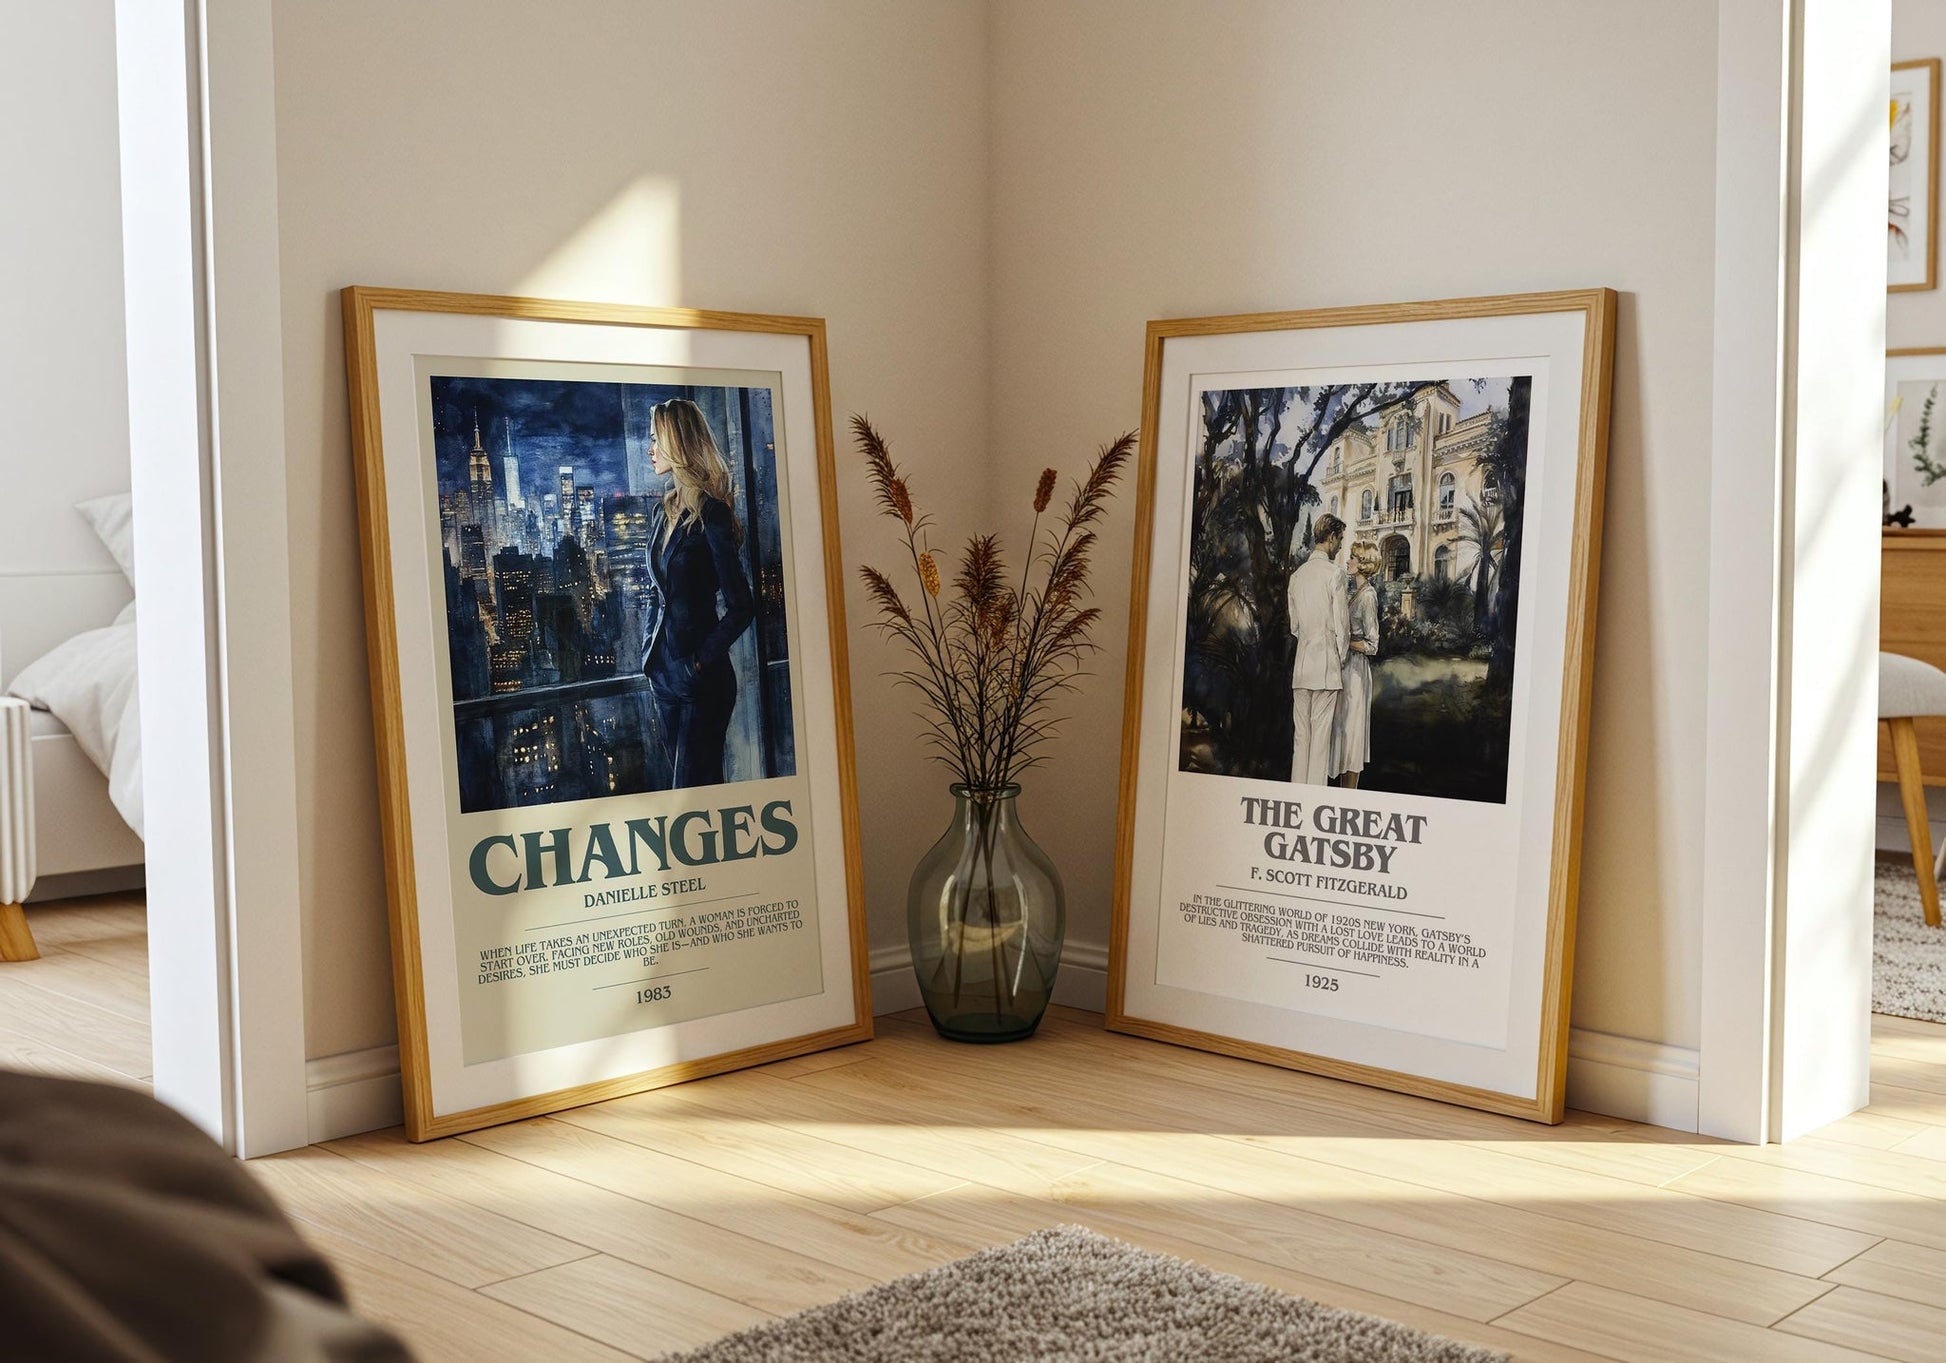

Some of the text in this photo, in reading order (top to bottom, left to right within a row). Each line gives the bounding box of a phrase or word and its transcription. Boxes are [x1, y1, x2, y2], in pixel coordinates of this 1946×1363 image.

[1241, 797, 1427, 844] THE GREAT
[469, 800, 798, 896] CHANGES
[1264, 832, 1398, 874] GATSBY
[584, 878, 706, 908] DANIELLE STEEL
[1251, 867, 1408, 900] F. SCOTT FITZGERALD
[480, 947, 512, 960] WHEN
[515, 943, 537, 954] LIFE
[540, 937, 573, 949] TAKES
[576, 934, 590, 944] AN
[592, 922, 656, 942] UNEXPECTED
[690, 917, 696, 925] A
[698, 911, 734, 924] WOMAN
[737, 909, 746, 918] IS
[748, 902, 783, 916] FORCED
[786, 900, 798, 909] TO
[1179, 903, 1486, 958] DESTRUCTIVE OBSESSION WITH A LOST LOVE LEADS TO A WORLD
[1193, 894, 1202, 903] IN
[1204, 895, 1221, 906] THE
[1224, 899, 1275, 915] GLITTERING
[1278, 907, 1311, 920] WORLD
[1315, 912, 1327, 922] OF
[1331, 915, 1361, 928] 1920S
[1364, 920, 1385, 931] NEW
[480, 958, 513, 972] START
[552, 947, 589, 960] FACING
[593, 941, 614, 952] NEW
[656, 931, 675, 942] OLD
[725, 920, 744, 931] AND
[747, 910, 799, 927] UNCHARTED
[529, 963, 550, 975] SHE
[553, 959, 580, 971] MUST
[584, 951, 621, 966] DECIDE
[624, 947, 647, 958] WHO
[650, 942, 669, 954] SHE
[713, 931, 734, 943] WHO
[738, 927, 755, 939] SHE
[758, 922, 788, 935] WANTS
[791, 920, 802, 929] TO
[643, 956, 659, 967] BE.
[1184, 913, 1196, 923] OF
[1198, 915, 1216, 927] LIES
[1219, 919, 1238, 930] AND
[1287, 930, 1299, 939] AS
[1301, 931, 1339, 946] DREAMS
[1342, 938, 1383, 953] COLLIDE
[1387, 945, 1412, 958] WITH
[1415, 949, 1456, 965] REALITY
[1458, 956, 1469, 967] IN
[1472, 959, 1479, 968] A
[1242, 933, 1409, 968] SHATTERED PURSUIT OF HAPPINESS.
[636, 985, 672, 1004] 1983
[1304, 974, 1339, 992] 1925
